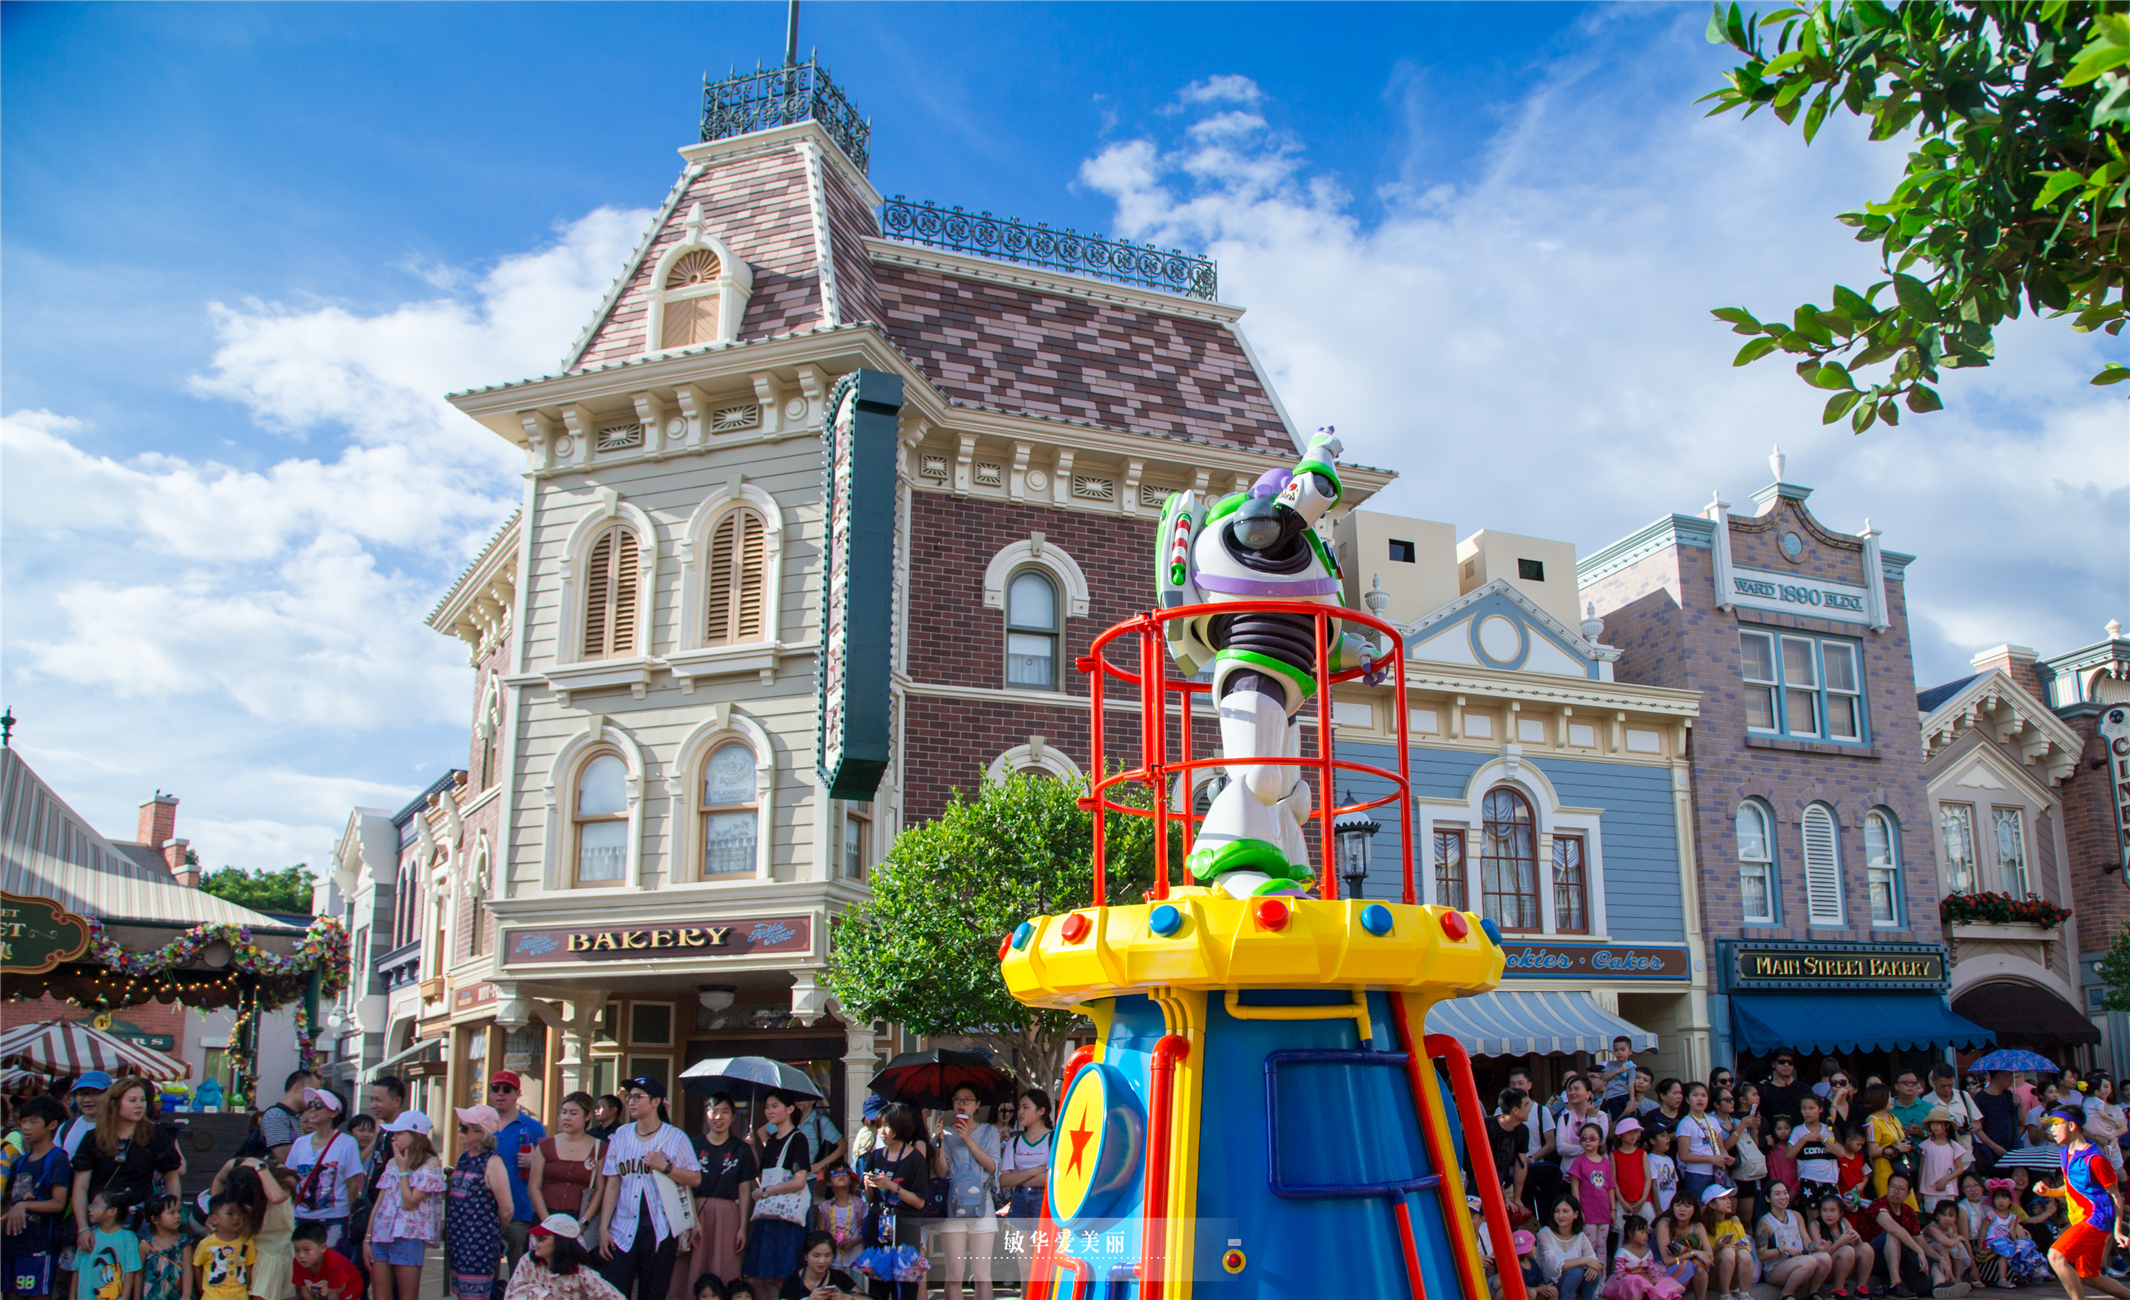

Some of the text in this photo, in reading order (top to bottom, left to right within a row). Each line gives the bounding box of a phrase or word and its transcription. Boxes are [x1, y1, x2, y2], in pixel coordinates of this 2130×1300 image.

[1734, 579, 1863, 610] WARD 1890 BLDG.
[566, 926, 732, 952] BAKERY
[1505, 947, 1665, 970] okies Cakes
[1755, 956, 1931, 976] MAIN STREET BAKERY
[1803, 1146, 1825, 1155] CONV
[16, 1275, 37, 1290] 98
